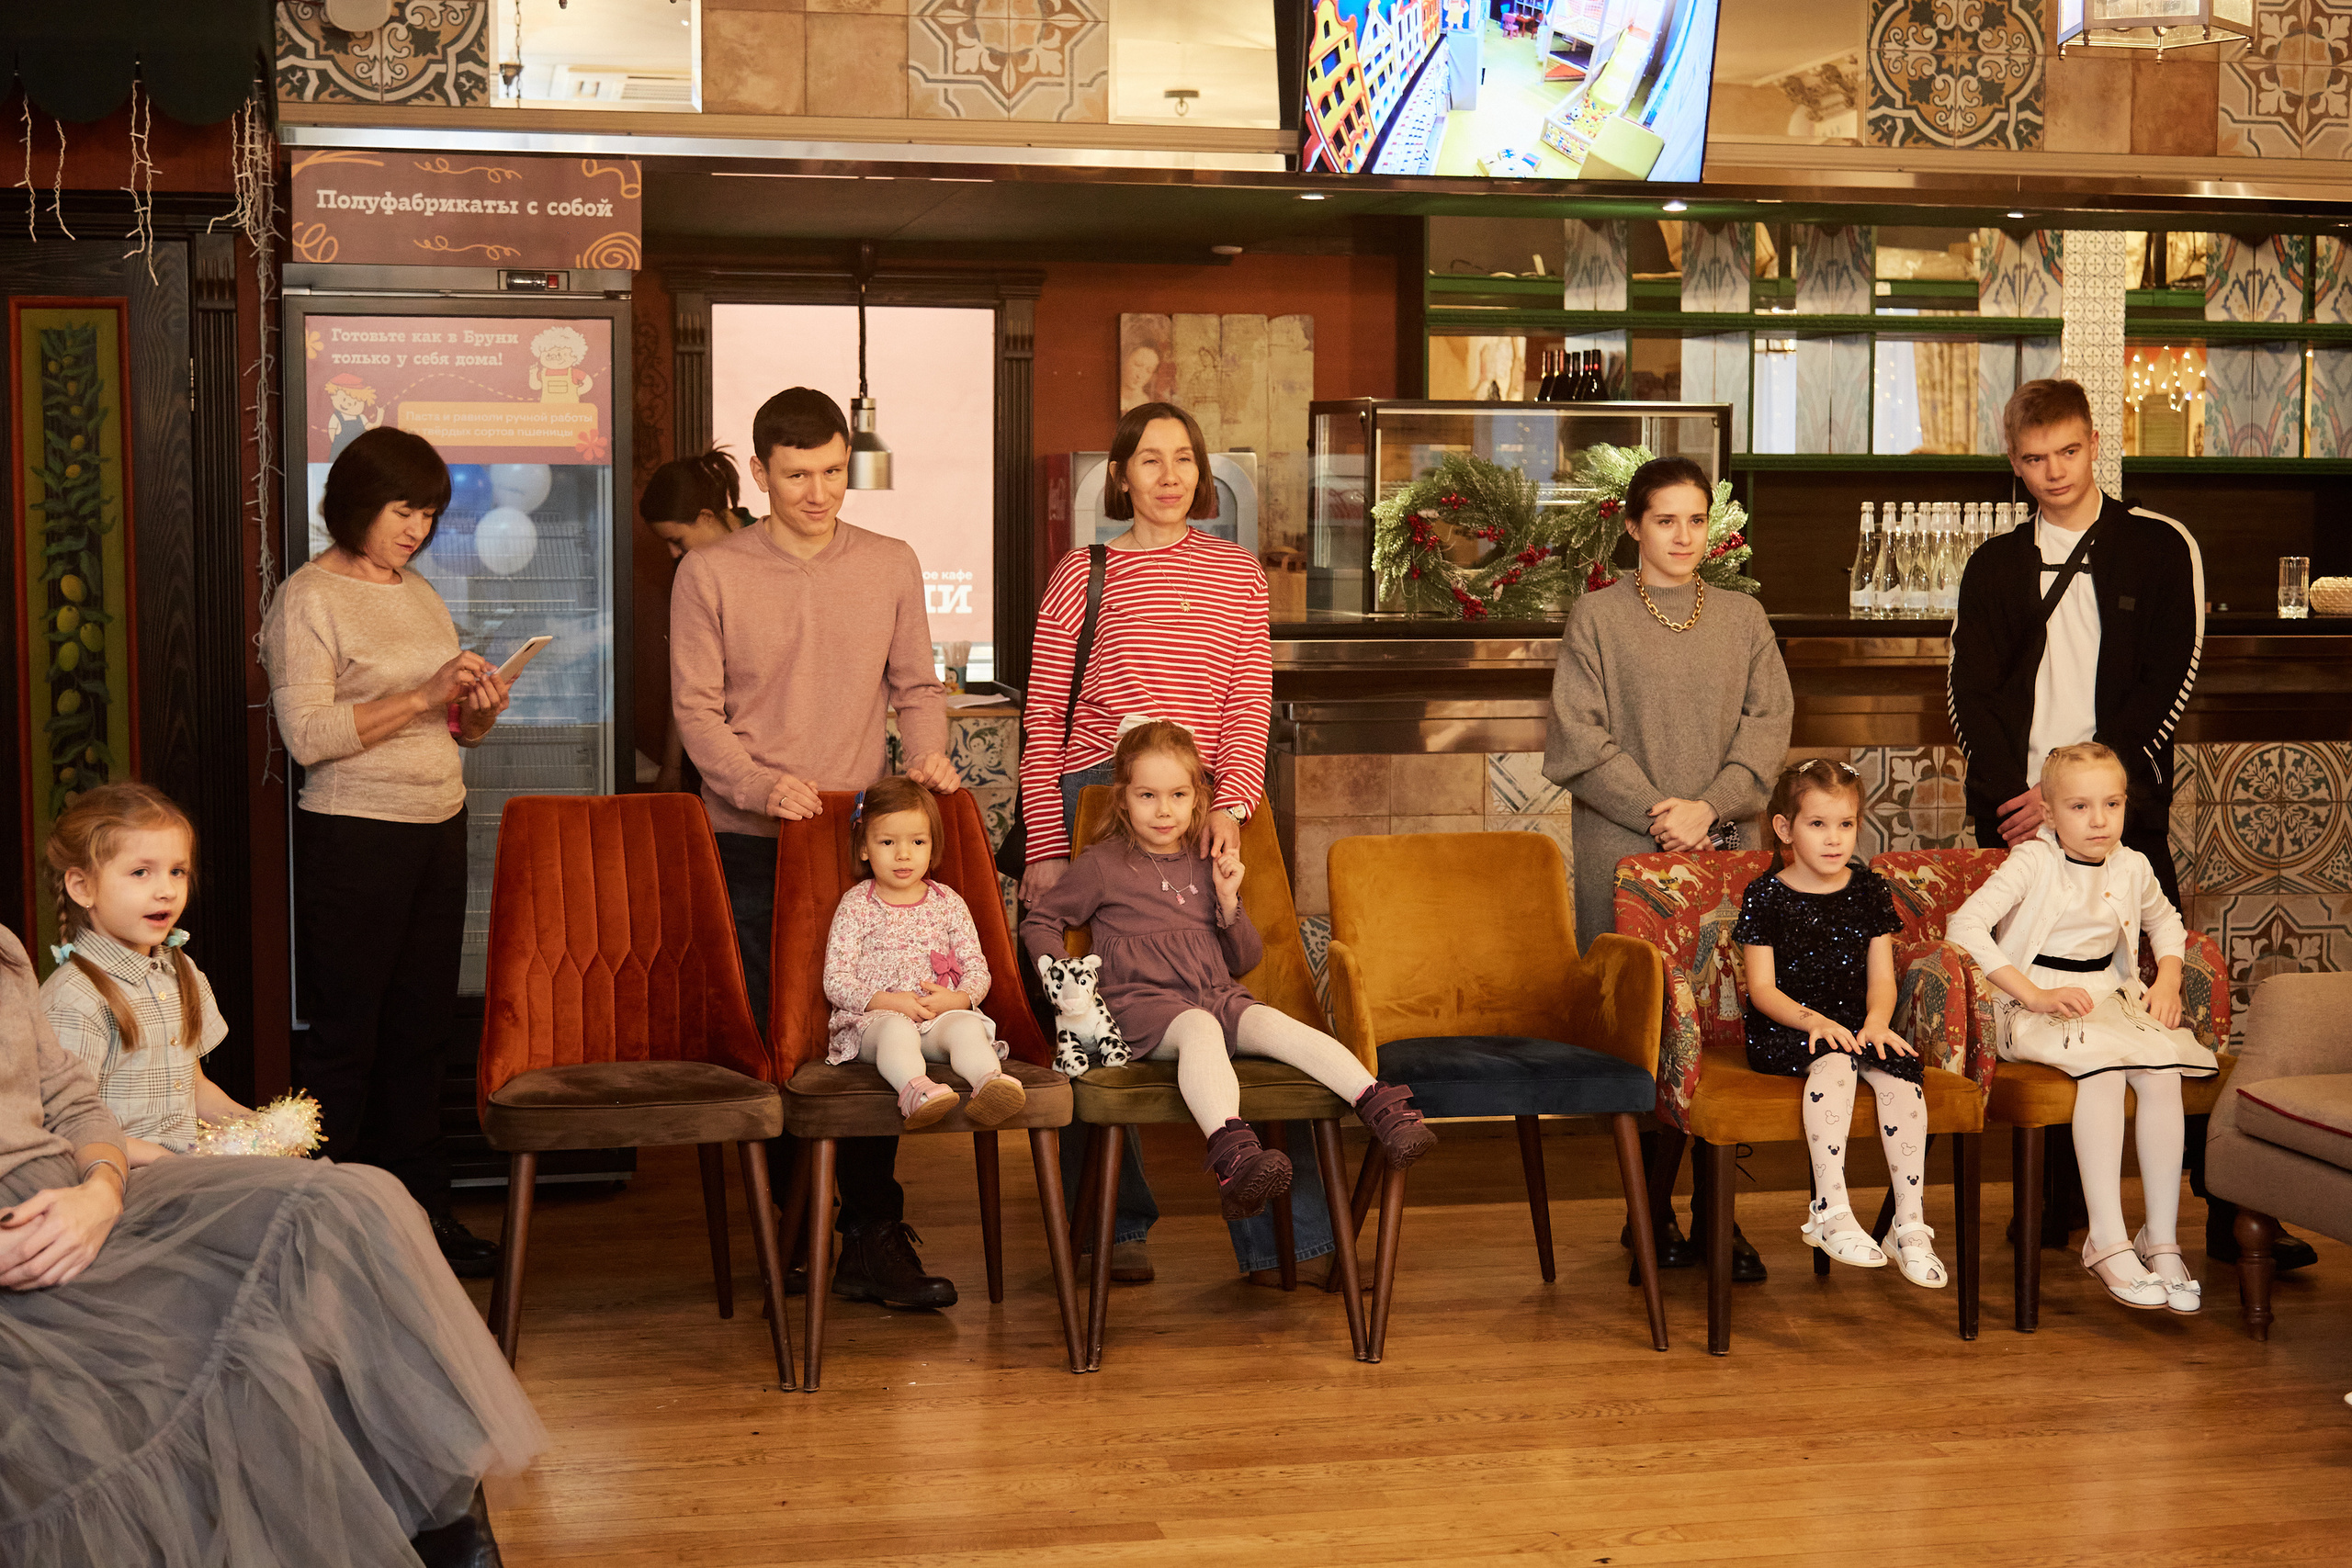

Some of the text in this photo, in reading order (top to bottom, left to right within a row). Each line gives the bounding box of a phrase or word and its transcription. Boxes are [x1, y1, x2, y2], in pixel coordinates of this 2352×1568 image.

[316, 189, 613, 218] Полуфабрикаты с собой
[331, 328, 519, 346] Готовьте как в Бруни
[332, 352, 503, 367] только у себя дома!
[406, 412, 594, 424] Паста и равиоли ручной работы
[423, 425, 471, 437] твёрдых
[474, 428, 514, 438] сортов
[517, 428, 573, 438] пшеницы
[941, 569, 973, 583] кафе
